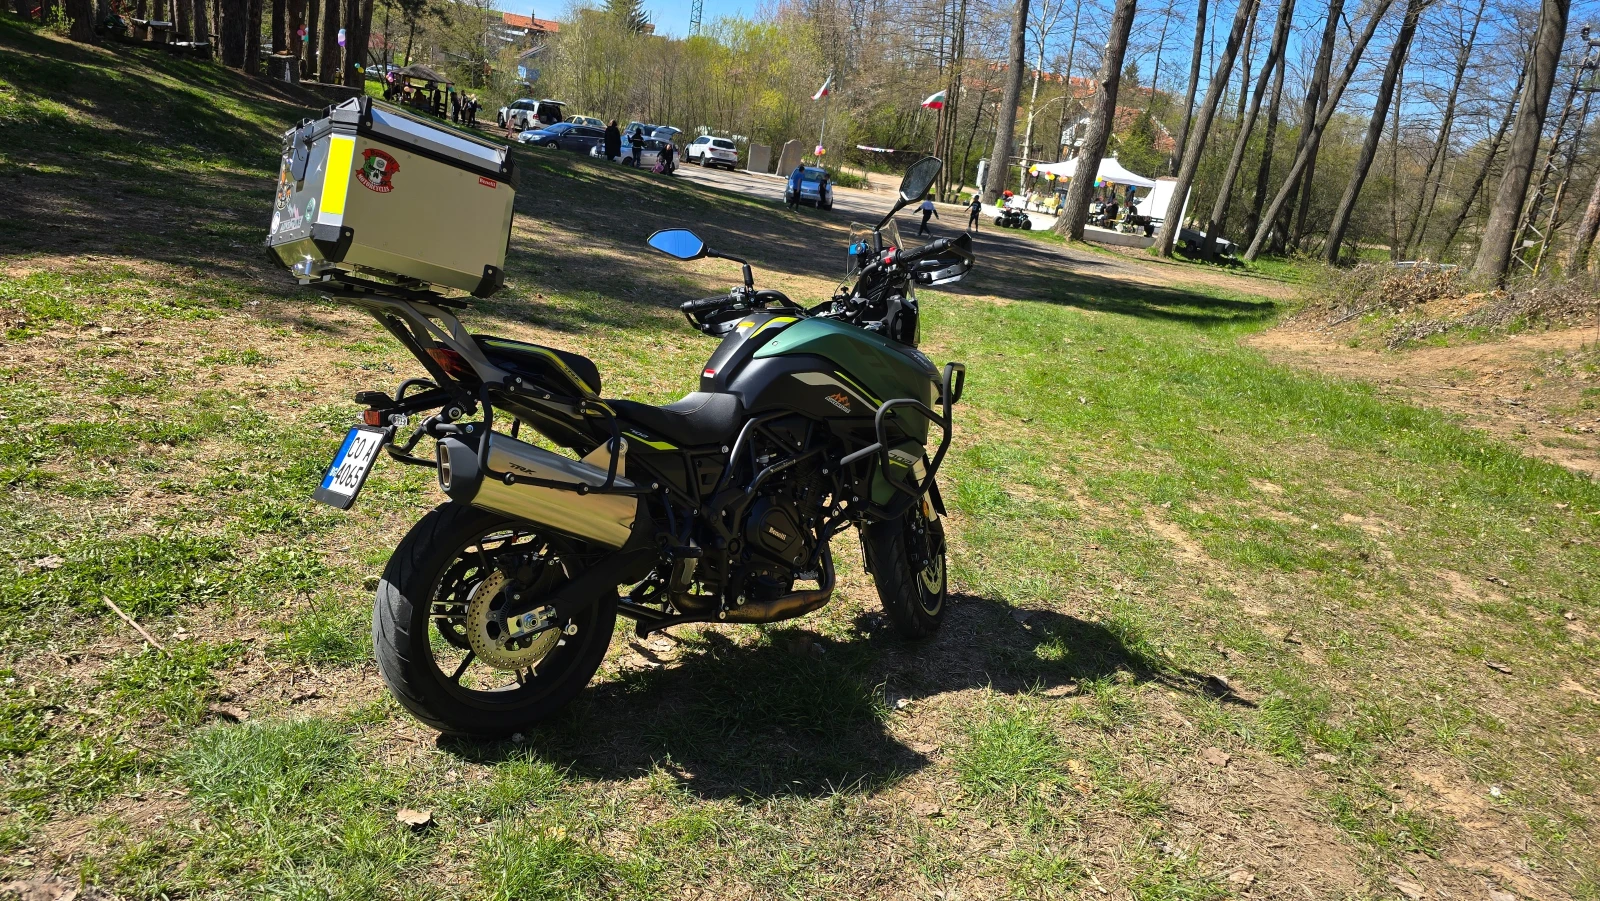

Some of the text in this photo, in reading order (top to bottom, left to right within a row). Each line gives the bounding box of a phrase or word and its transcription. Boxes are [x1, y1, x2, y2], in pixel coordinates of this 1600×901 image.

[347, 436, 376, 462] CO A
[335, 462, 364, 489] 4065
[509, 462, 537, 475] TRK
